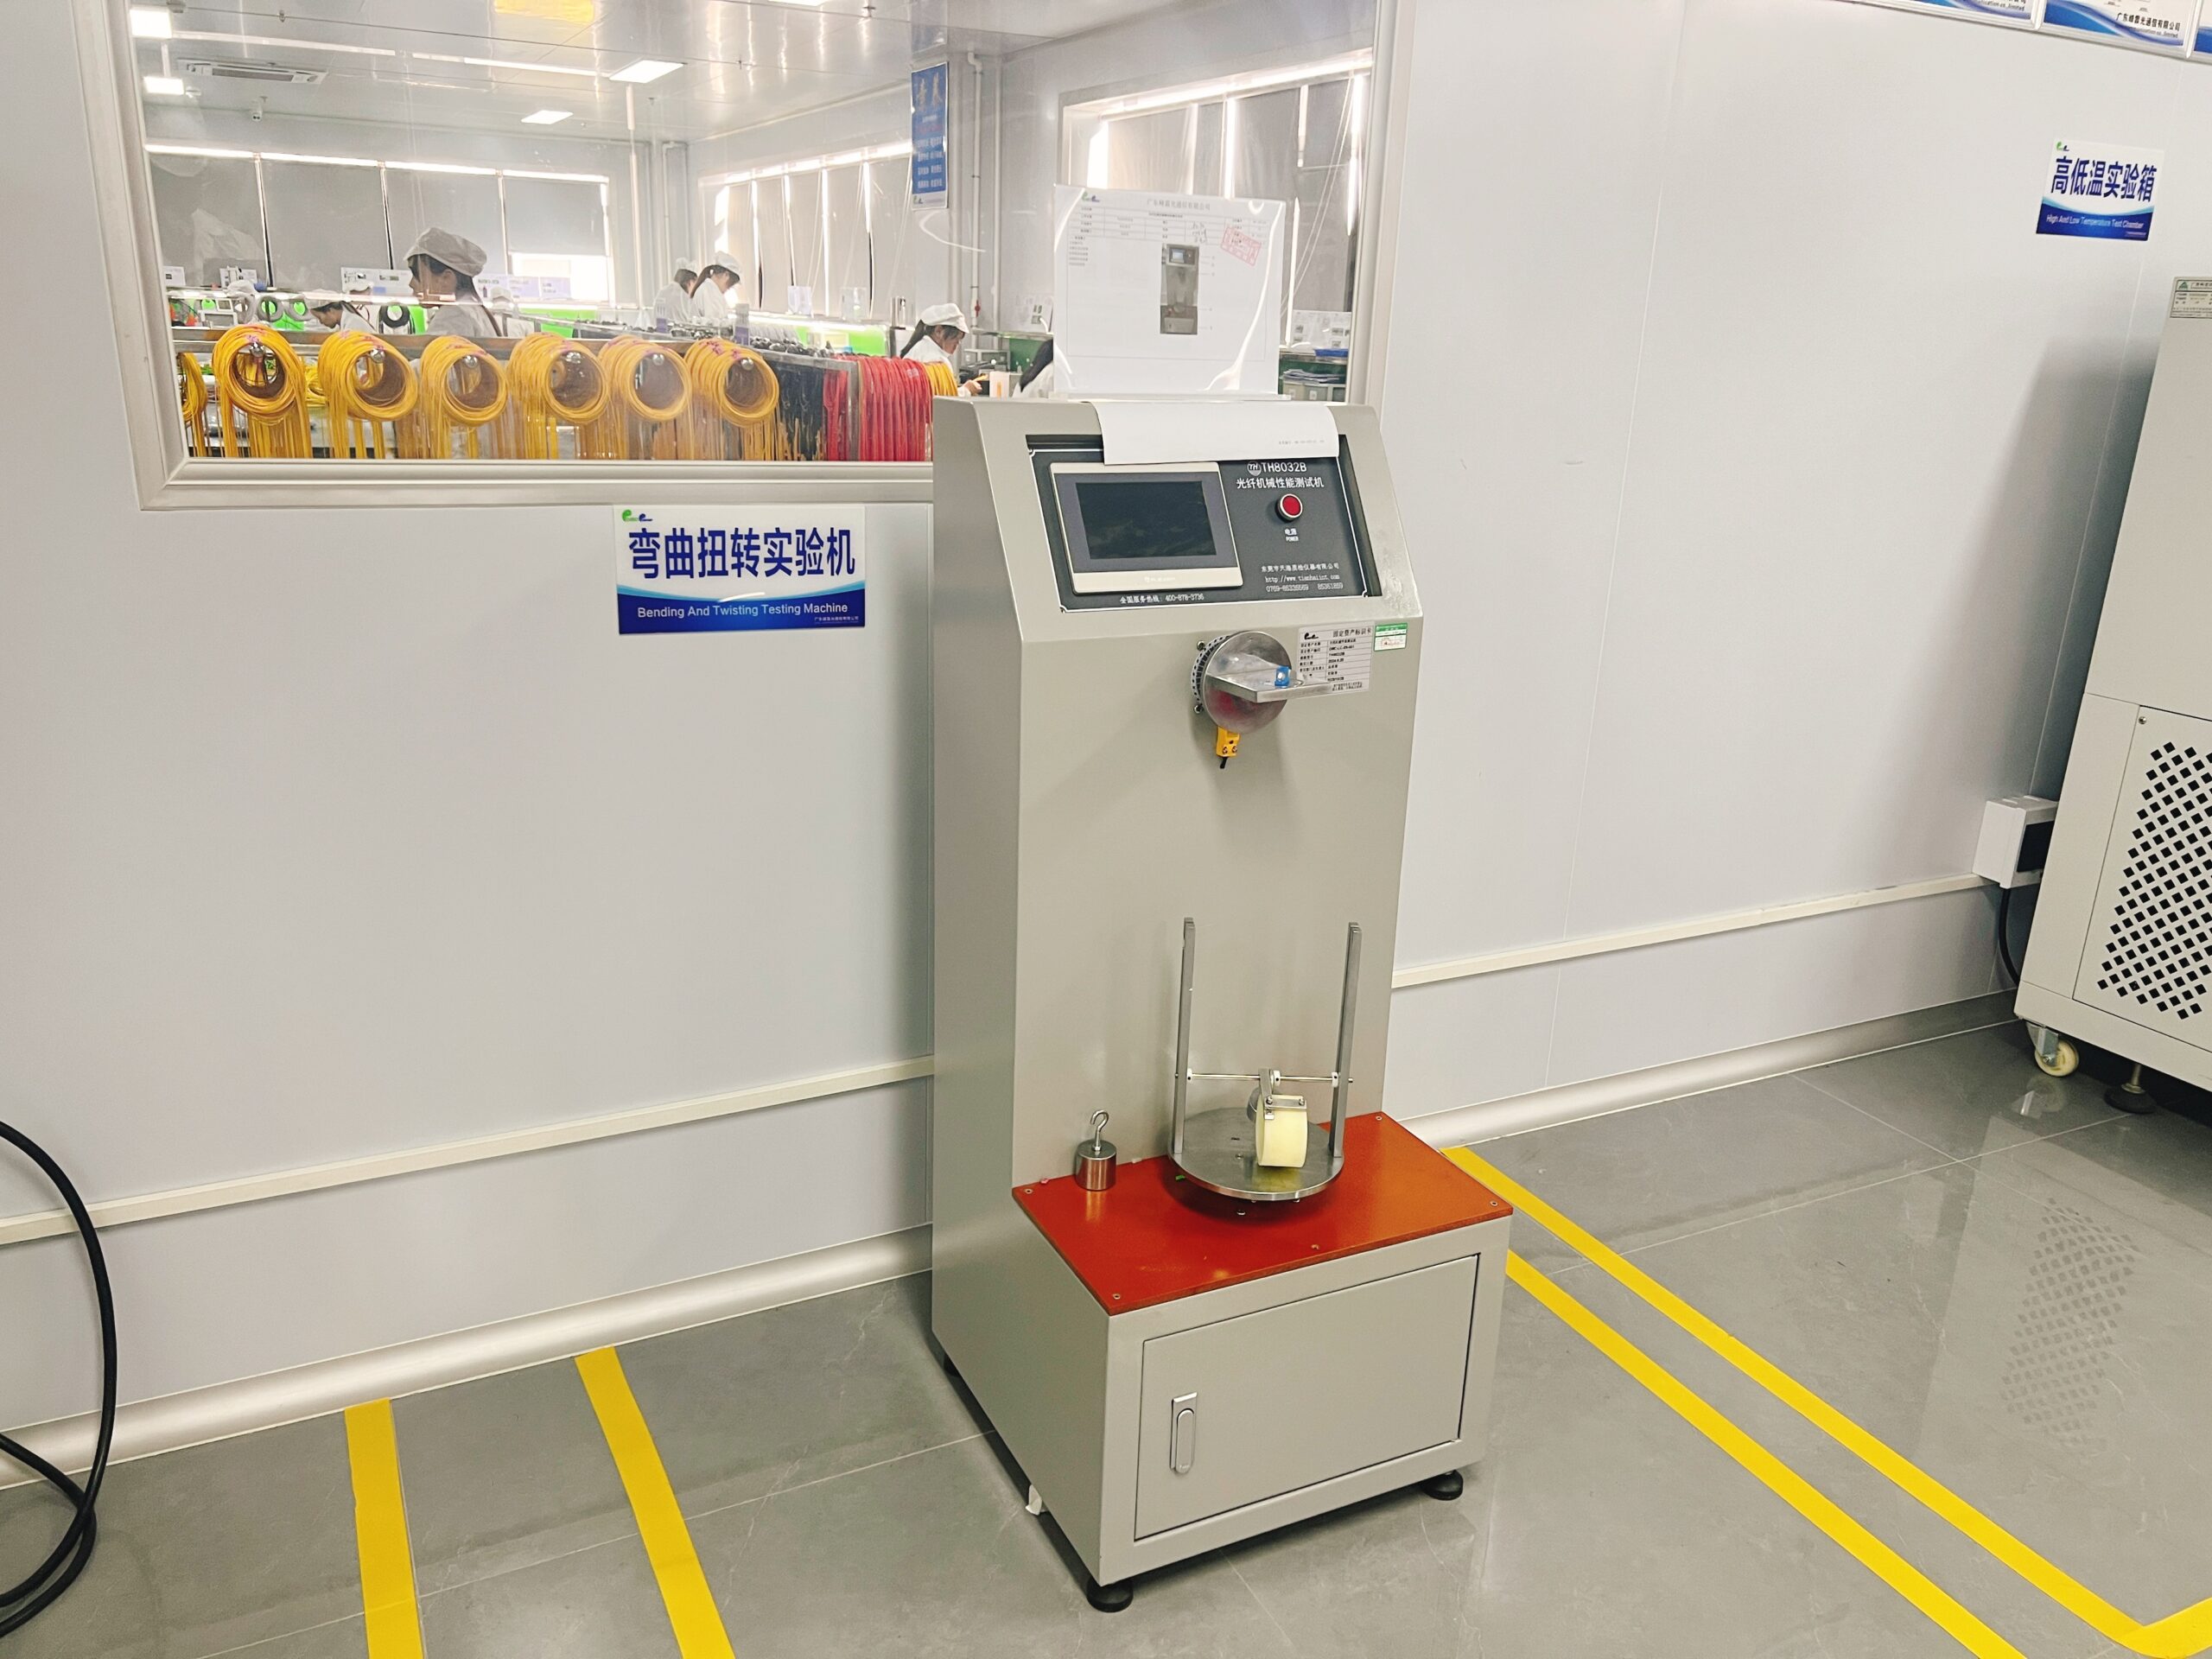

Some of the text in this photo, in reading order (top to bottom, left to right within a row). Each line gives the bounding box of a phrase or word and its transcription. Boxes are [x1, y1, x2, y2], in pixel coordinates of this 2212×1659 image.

[2050, 156, 2157, 202] 高低温实验箱
[1262, 462, 1307, 473] TH8032B
[1236, 477, 1325, 490] 光纤机械性能测试机
[628, 527, 855, 579] 弯曲扭转实验机
[638, 602, 849, 619] Bending And Twisting Testing Machine
